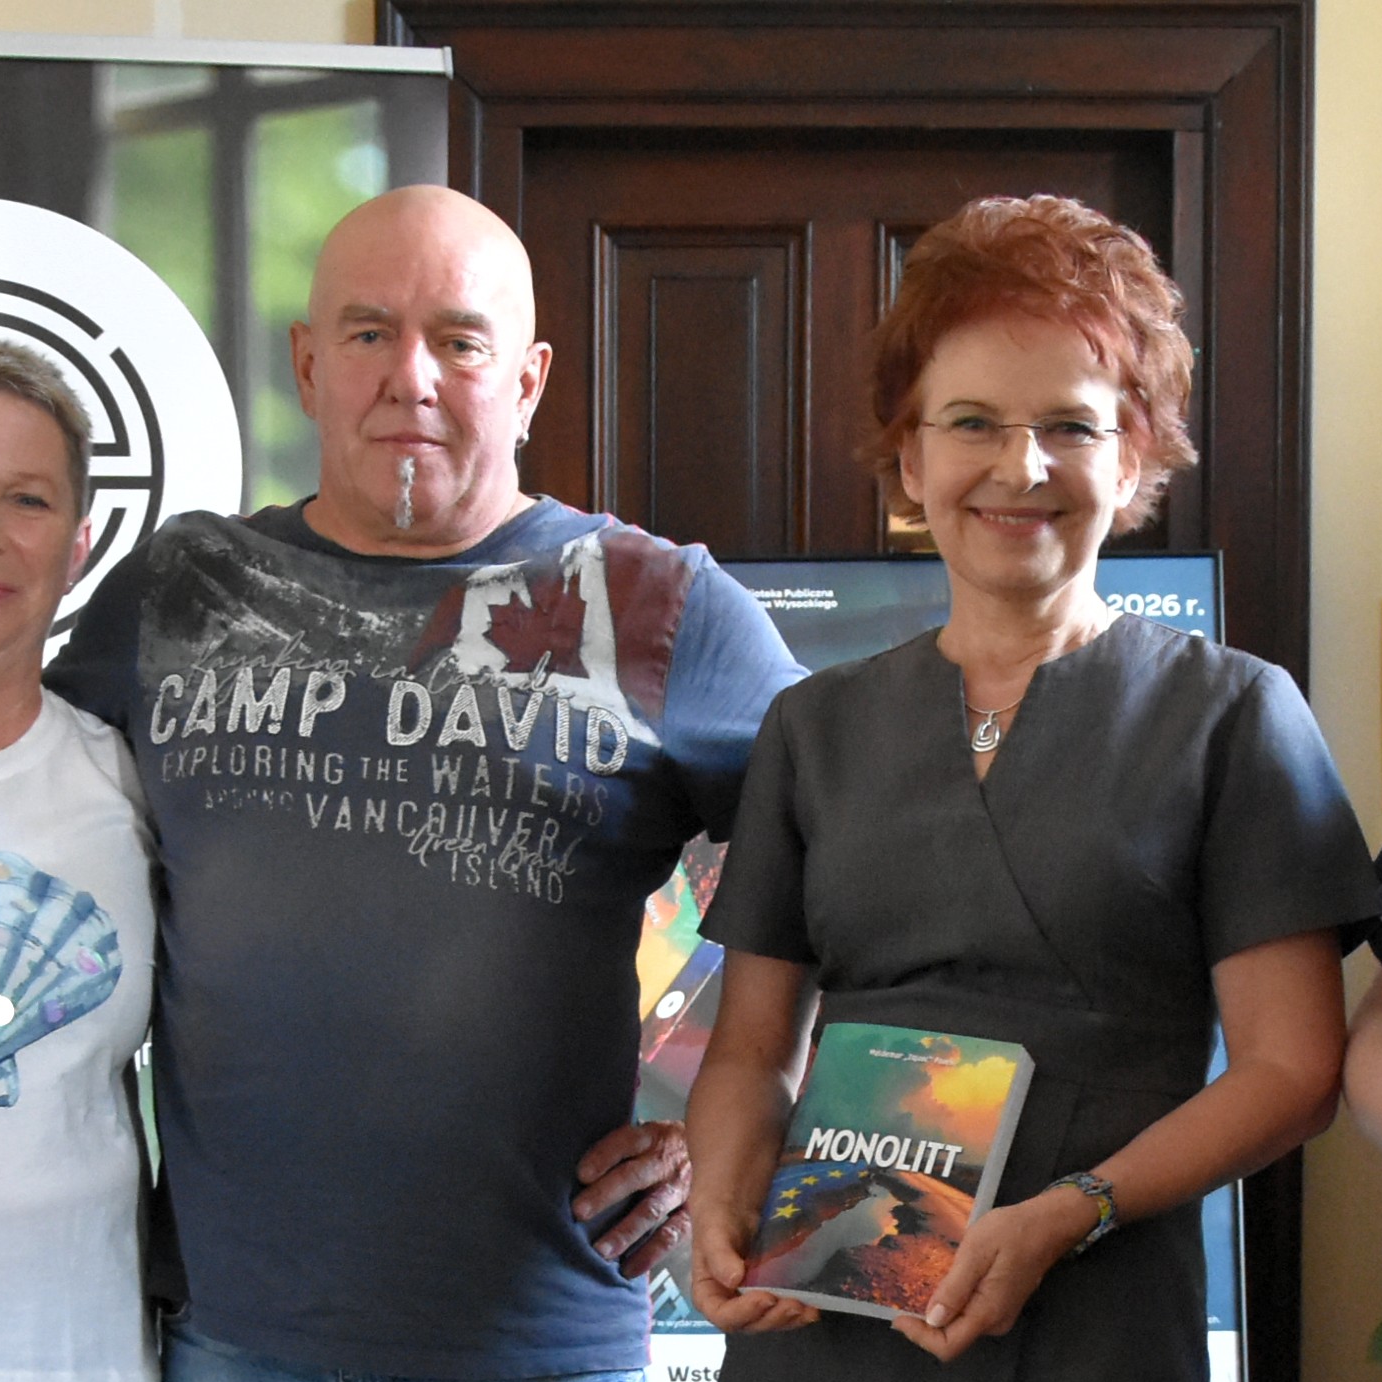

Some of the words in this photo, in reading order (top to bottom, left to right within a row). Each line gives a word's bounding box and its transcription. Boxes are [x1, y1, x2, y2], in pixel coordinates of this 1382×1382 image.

[774, 599, 838, 610] Wysockiego
[784, 588, 834, 598] Publiczna
[1106, 593, 1181, 617] 2026
[1185, 598, 1206, 616] r.
[150, 667, 346, 745] CAMP
[386, 680, 628, 776] DAVID
[161, 745, 344, 785] EXPLORING
[360, 756, 409, 782] THE
[432, 753, 608, 826] WATERS
[307, 793, 560, 858] VANCOUVER
[451, 851, 563, 903] ISLAND
[804, 1127, 963, 1178] MONOLITT
